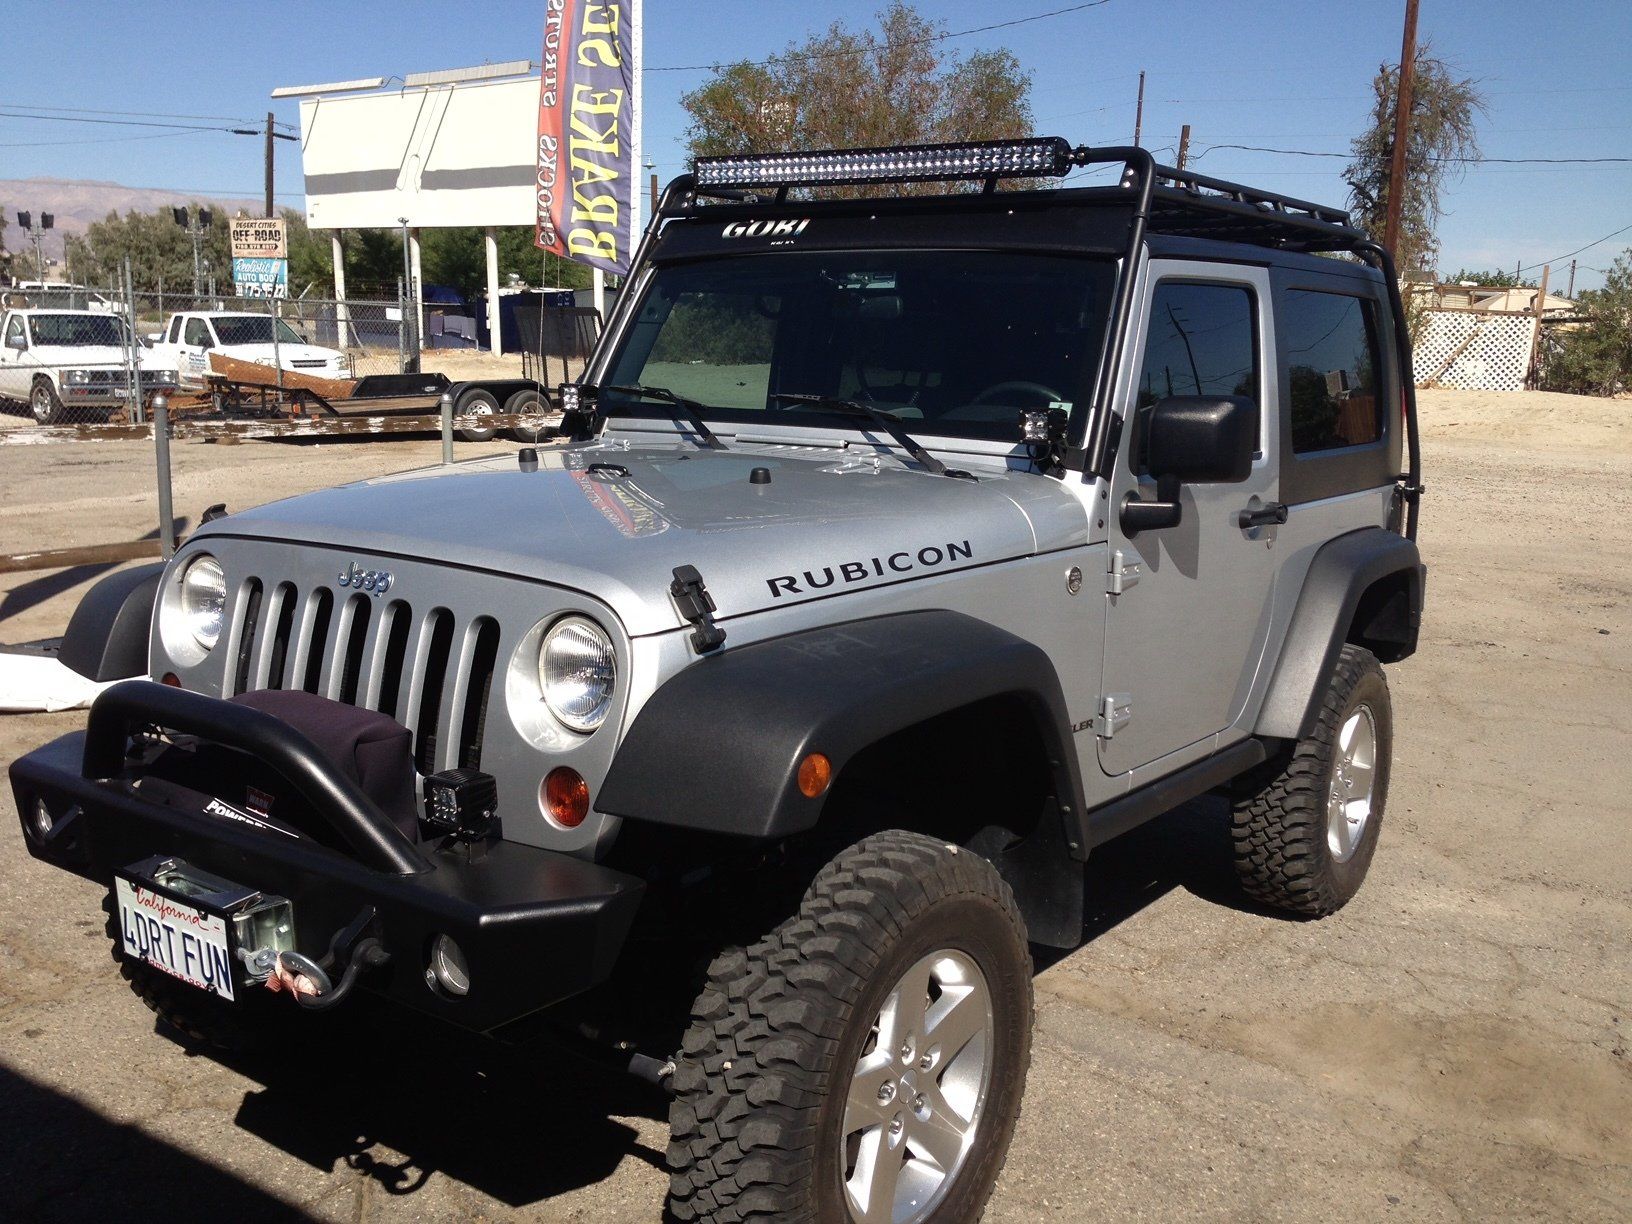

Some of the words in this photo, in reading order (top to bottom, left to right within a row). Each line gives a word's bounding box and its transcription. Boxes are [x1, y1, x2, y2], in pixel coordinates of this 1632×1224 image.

[233, 230, 281, 242] OFF-ROAD
[235, 258, 270, 274] Realistic
[237, 274, 257, 282] AUTO
[338, 561, 394, 598] Jeep
[766, 540, 973, 598] RUBICON
[1072, 719, 1094, 733] LER
[136, 885, 213, 932] California
[123, 906, 175, 970] 4DRT
[181, 931, 232, 994] FUN
